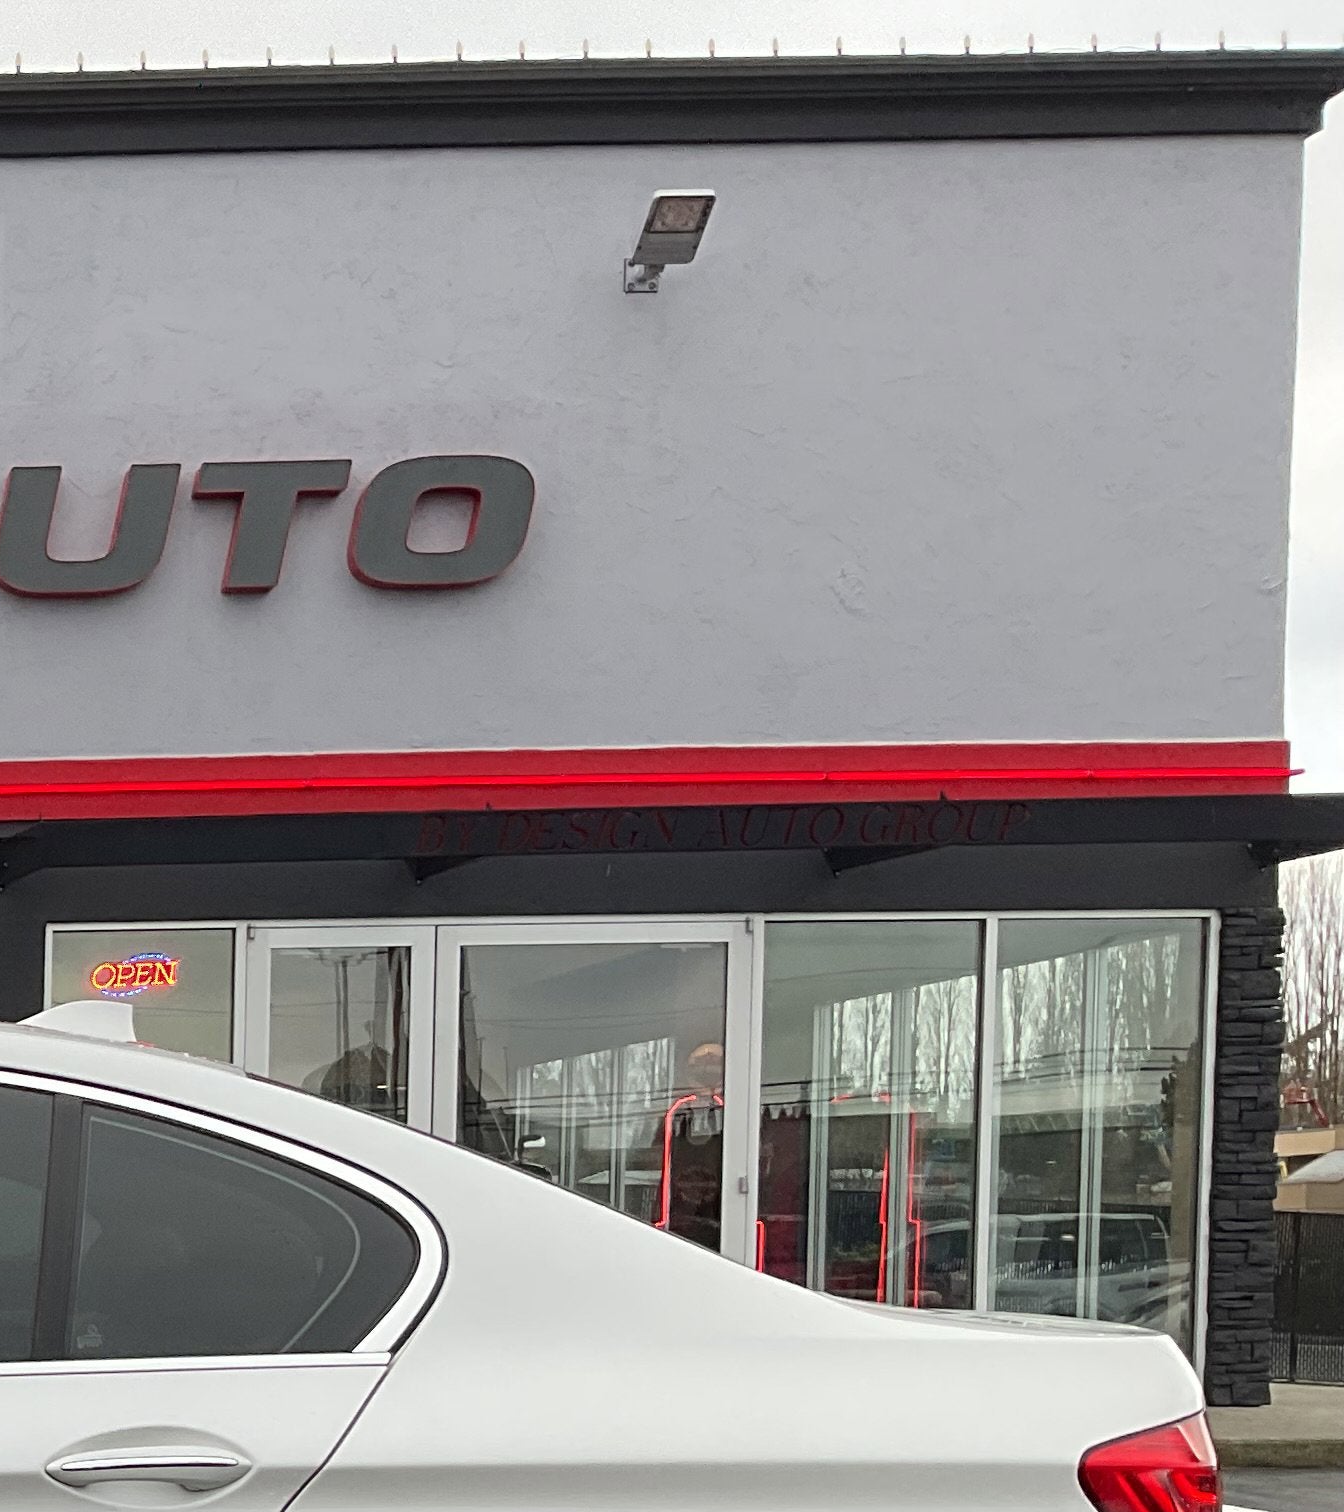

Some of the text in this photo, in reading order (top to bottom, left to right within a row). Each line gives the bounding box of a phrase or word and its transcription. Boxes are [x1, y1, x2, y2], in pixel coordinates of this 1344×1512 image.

[416, 802, 1032, 853] BY DESIGN AUTO GROUP
[90, 959, 181, 990] OPEN
